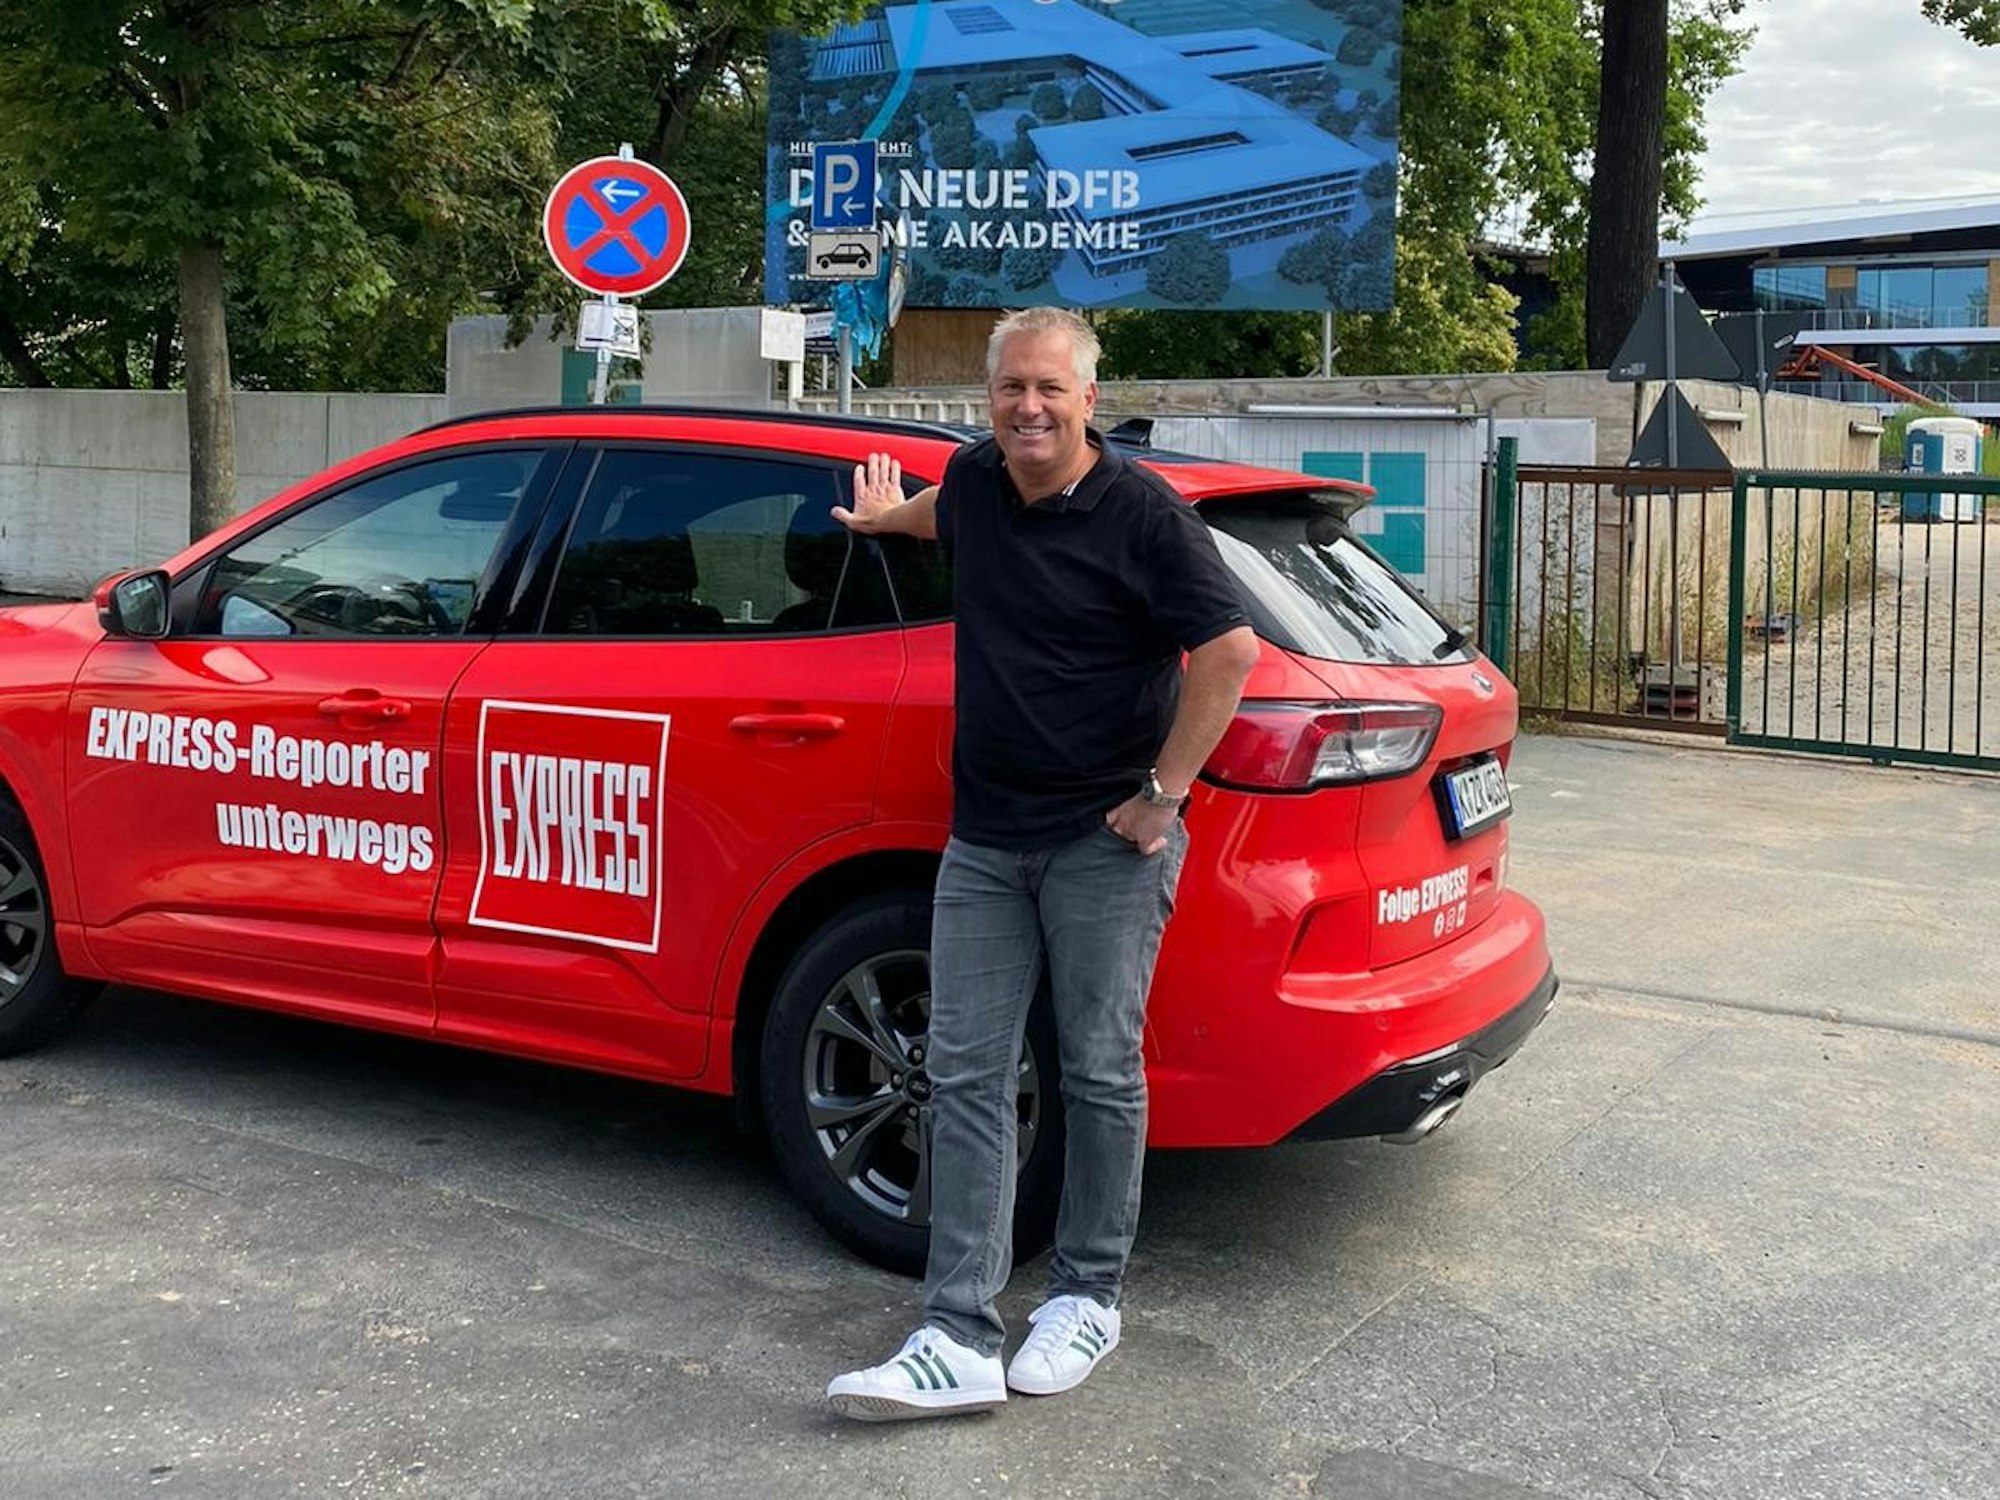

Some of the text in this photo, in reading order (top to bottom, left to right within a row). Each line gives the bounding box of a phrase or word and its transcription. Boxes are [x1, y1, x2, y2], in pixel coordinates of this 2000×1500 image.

[824, 154, 860, 218] P
[899, 169, 1029, 209] NEUE
[1046, 169, 1140, 209] DFB
[786, 219, 810, 246] &
[942, 221, 1140, 250] AKADEMIE
[86, 706, 430, 795] EXPRESS-Reporter
[215, 802, 434, 874] unterwegs
[490, 751, 651, 897] EXPRESS
[1378, 864, 1469, 925] Folge EXPRESS
